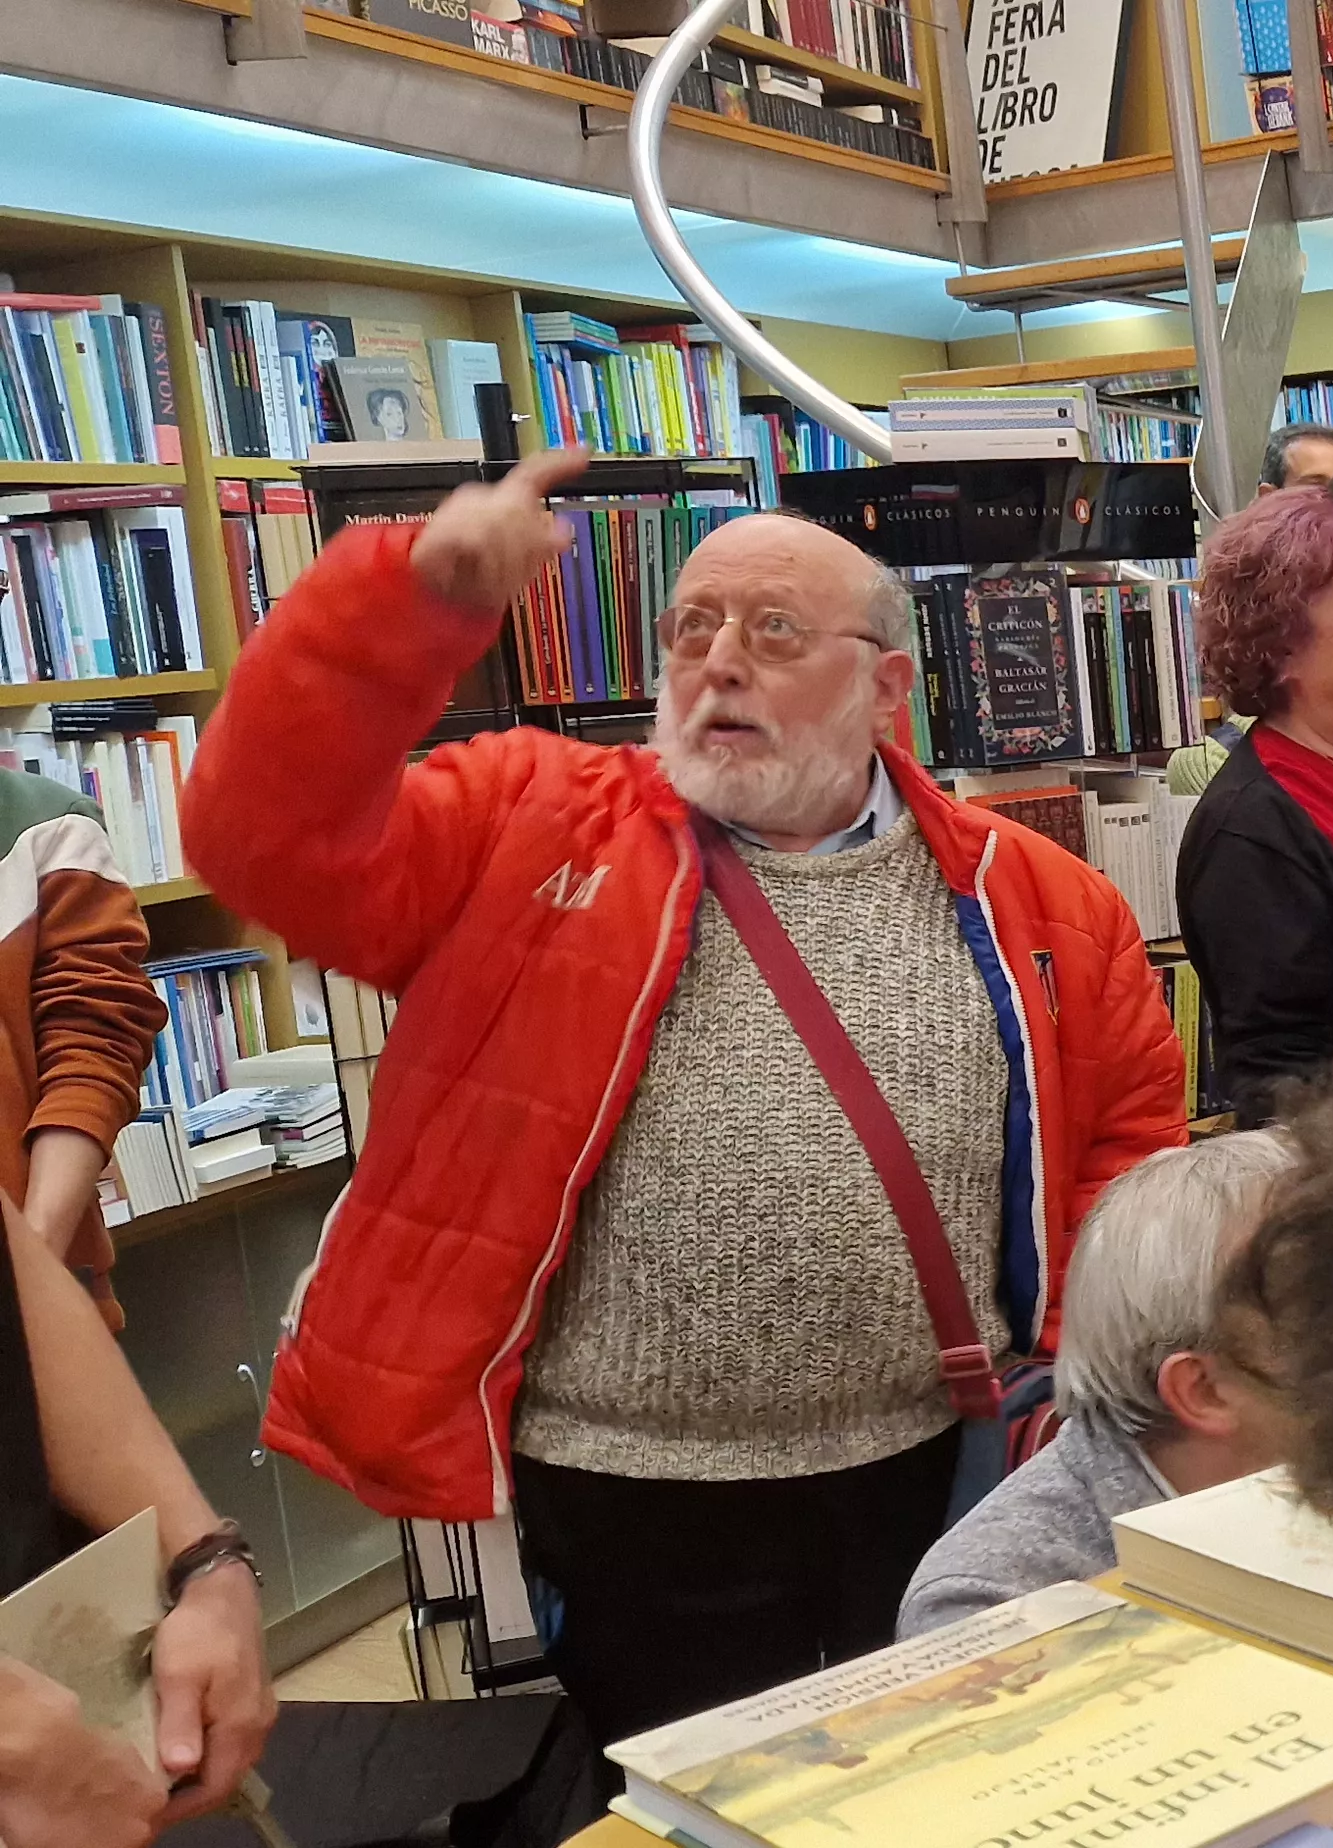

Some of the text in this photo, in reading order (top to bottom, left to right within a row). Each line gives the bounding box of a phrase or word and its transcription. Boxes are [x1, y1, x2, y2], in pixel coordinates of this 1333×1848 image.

[409, 0, 468, 21] PICASSO
[471, 17, 506, 43] KARL
[987, 0, 1066, 49] FERIA
[473, 35, 512, 60] MARX
[982, 46, 1030, 92] DEL
[977, 82, 1058, 134] LIBRO
[149, 314, 176, 416] SEXTON
[345, 513, 393, 527] Martin
[886, 507, 952, 522] CLÁSICOS
[976, 504, 1181, 518] PENGUIN CLÁSICOS
[1008, 605, 1021, 615] EL
[987, 618, 1043, 632] CRITICÓN
[995, 666, 1048, 679] BALTASAR
[999, 681, 1047, 694] GRACIÁN
[746, 1668, 892, 1723] AUMENTADA
[814, 1671, 919, 1713] VERSIÓN
[972, 1758, 1065, 1801] VALLEJO
[974, 1710, 1303, 1848] en un junc
